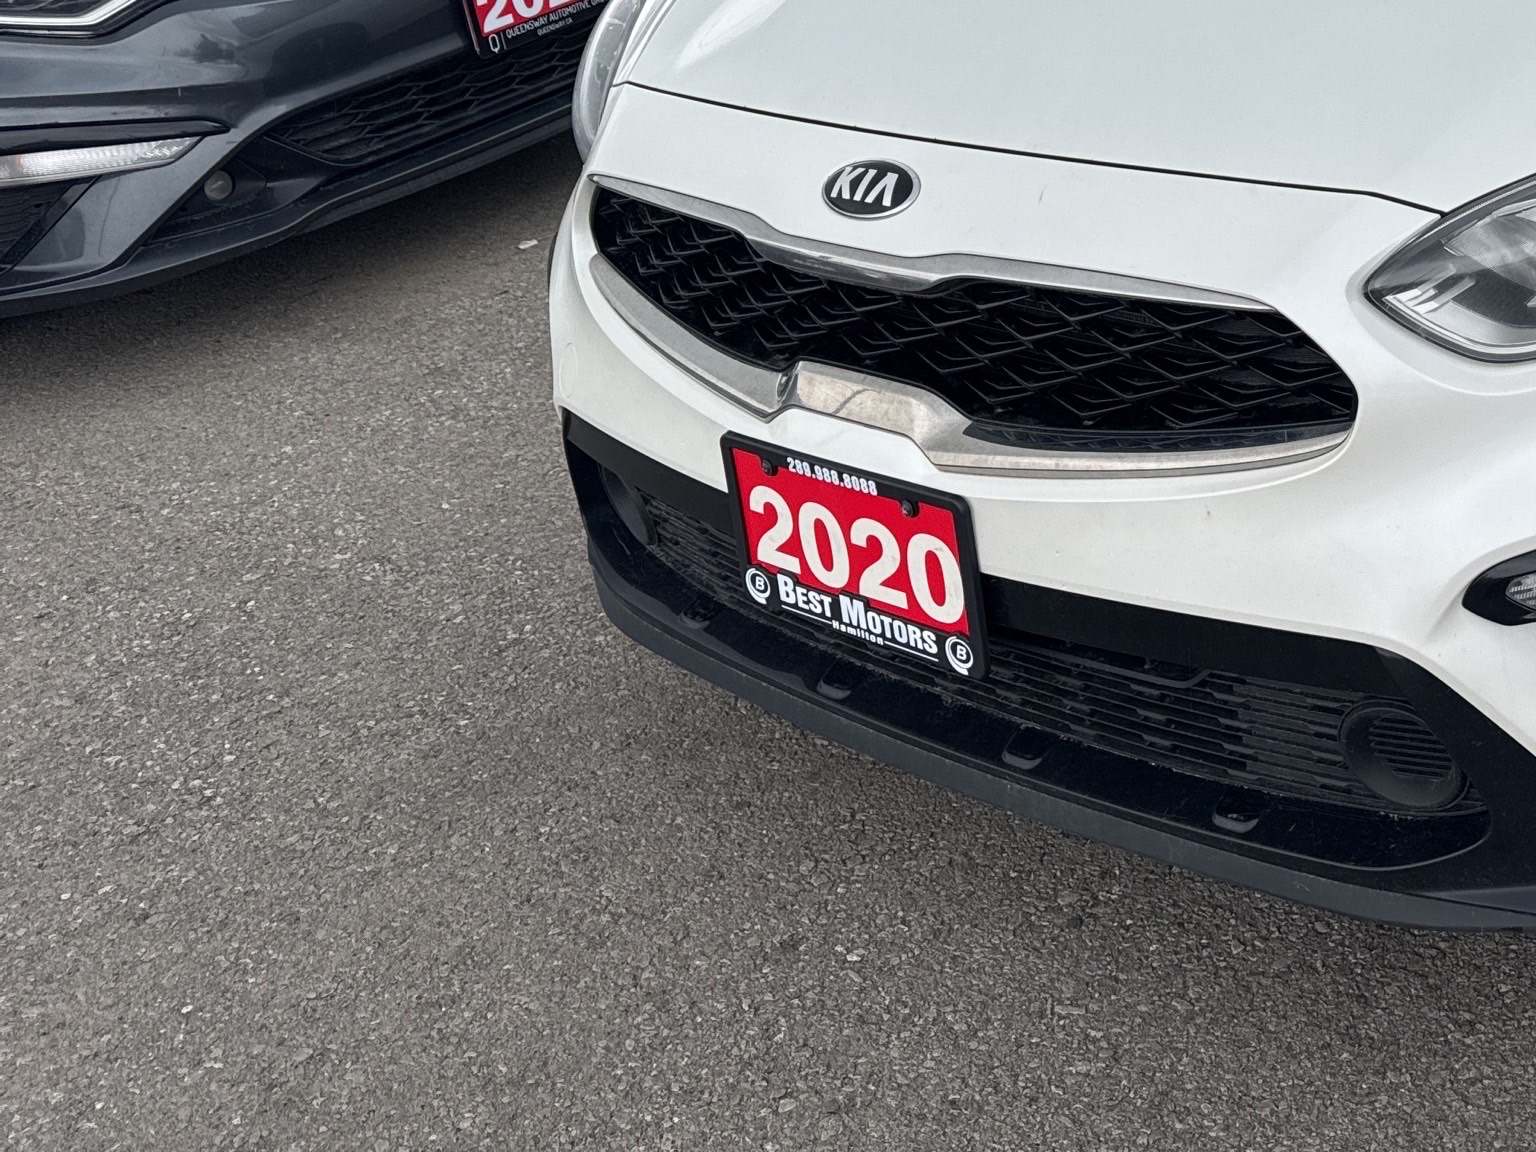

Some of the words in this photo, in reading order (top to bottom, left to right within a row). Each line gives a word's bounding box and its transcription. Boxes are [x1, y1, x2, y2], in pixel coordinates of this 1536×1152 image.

[505, 15, 551, 39] QUEENSWAY
[549, 0, 591, 22] AUTOMOTIVE
[830, 165, 899, 208] KIA
[786, 457, 878, 497] 289.988.8088
[749, 485, 965, 624] 2020
[776, 572, 832, 618] BEST
[839, 596, 938, 654] MOTORS
[832, 619, 884, 646] Hamilton
